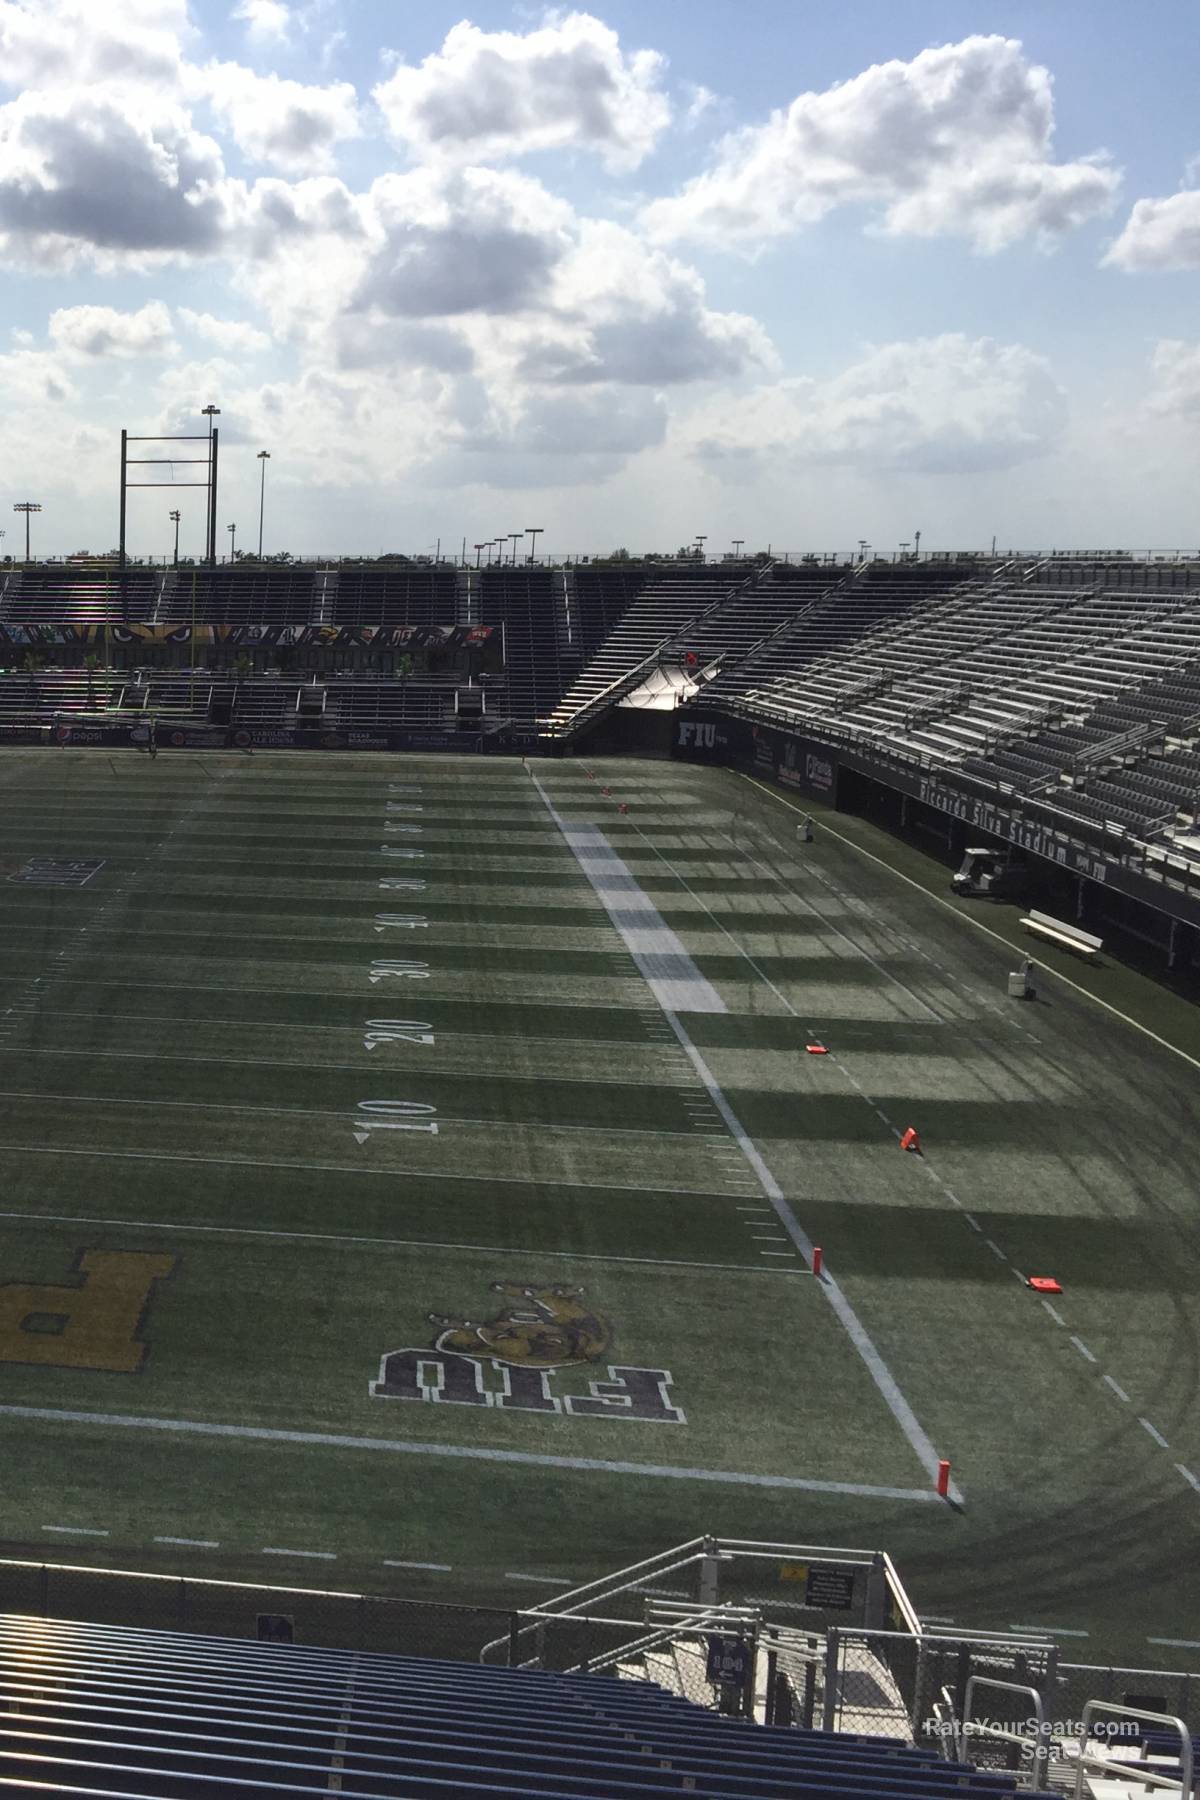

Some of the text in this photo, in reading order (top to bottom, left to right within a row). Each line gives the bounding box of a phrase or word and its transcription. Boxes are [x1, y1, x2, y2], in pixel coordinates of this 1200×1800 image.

[72, 730, 103, 743] pepsi
[678, 721, 716, 748] FIU
[919, 783, 967, 819] Riccardo
[973, 802, 1001, 834] Silva
[1008, 821, 1067, 865] Stadium
[374, 912, 430, 930] 40
[369, 958, 431, 979] 30
[363, 1019, 435, 1045] 20
[353, 1099, 439, 1135] 10
[368, 1347, 689, 1425] FIU
